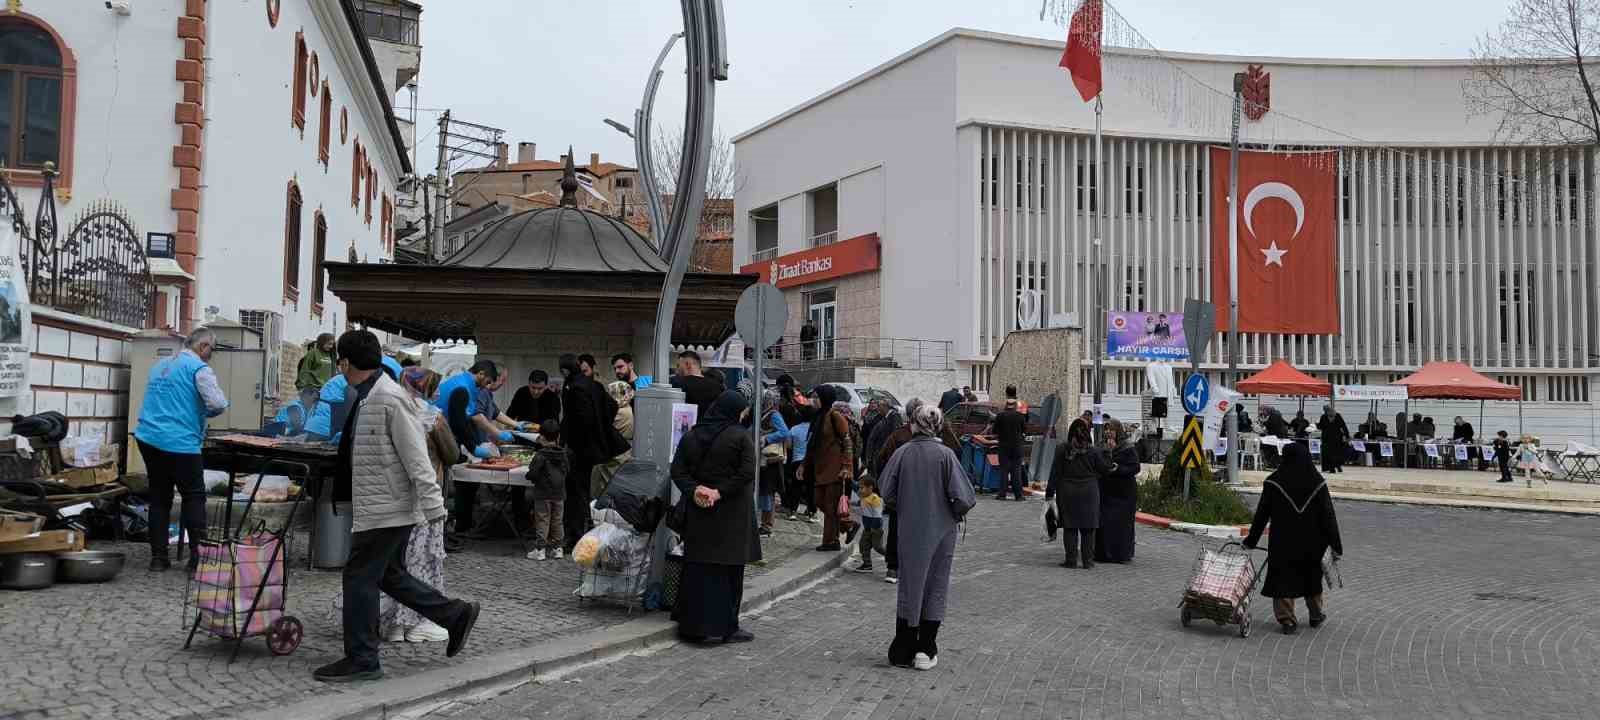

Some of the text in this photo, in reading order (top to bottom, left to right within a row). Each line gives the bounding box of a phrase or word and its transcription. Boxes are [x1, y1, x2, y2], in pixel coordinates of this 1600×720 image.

[779, 257, 832, 280] Ziraat Bankası
[1117, 344, 1149, 354] HAYIR
